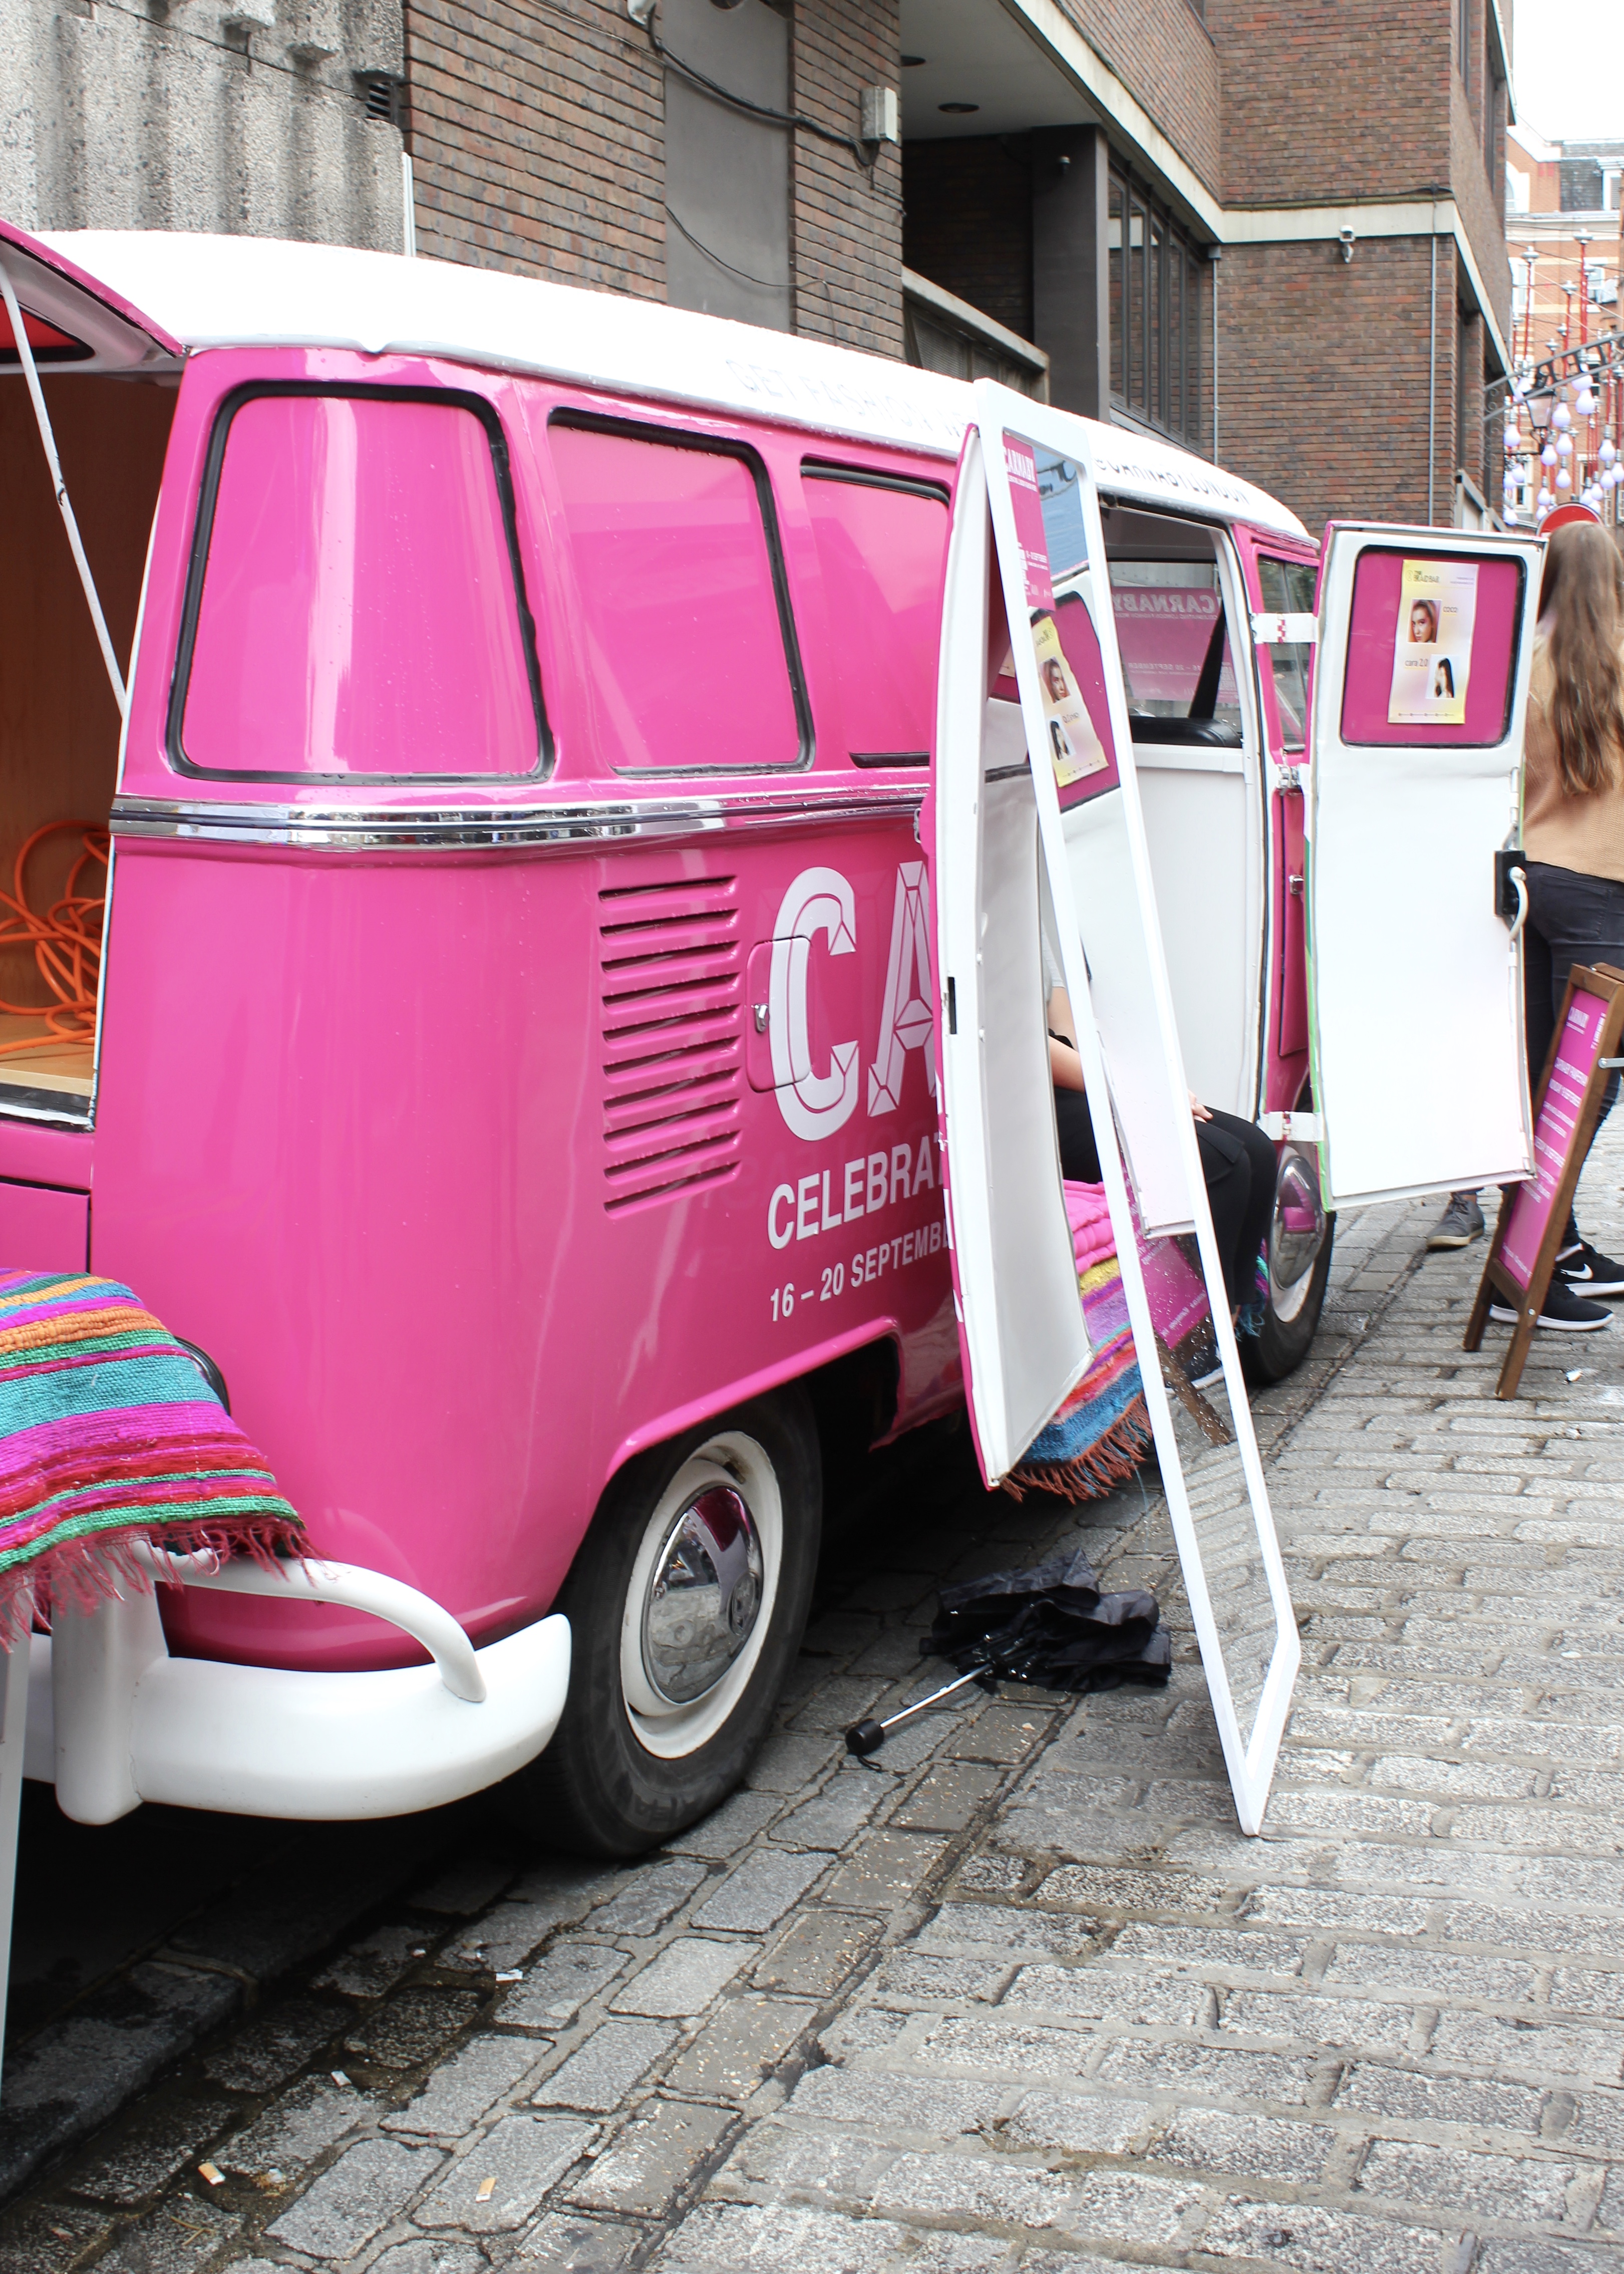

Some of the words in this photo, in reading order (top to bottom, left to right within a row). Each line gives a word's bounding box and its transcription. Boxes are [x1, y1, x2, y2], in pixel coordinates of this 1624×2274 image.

[725, 359, 798, 401] GET
[798, 375, 933, 432] FASHION
[769, 1282, 796, 1322] 16
[819, 1262, 845, 1302] 20
